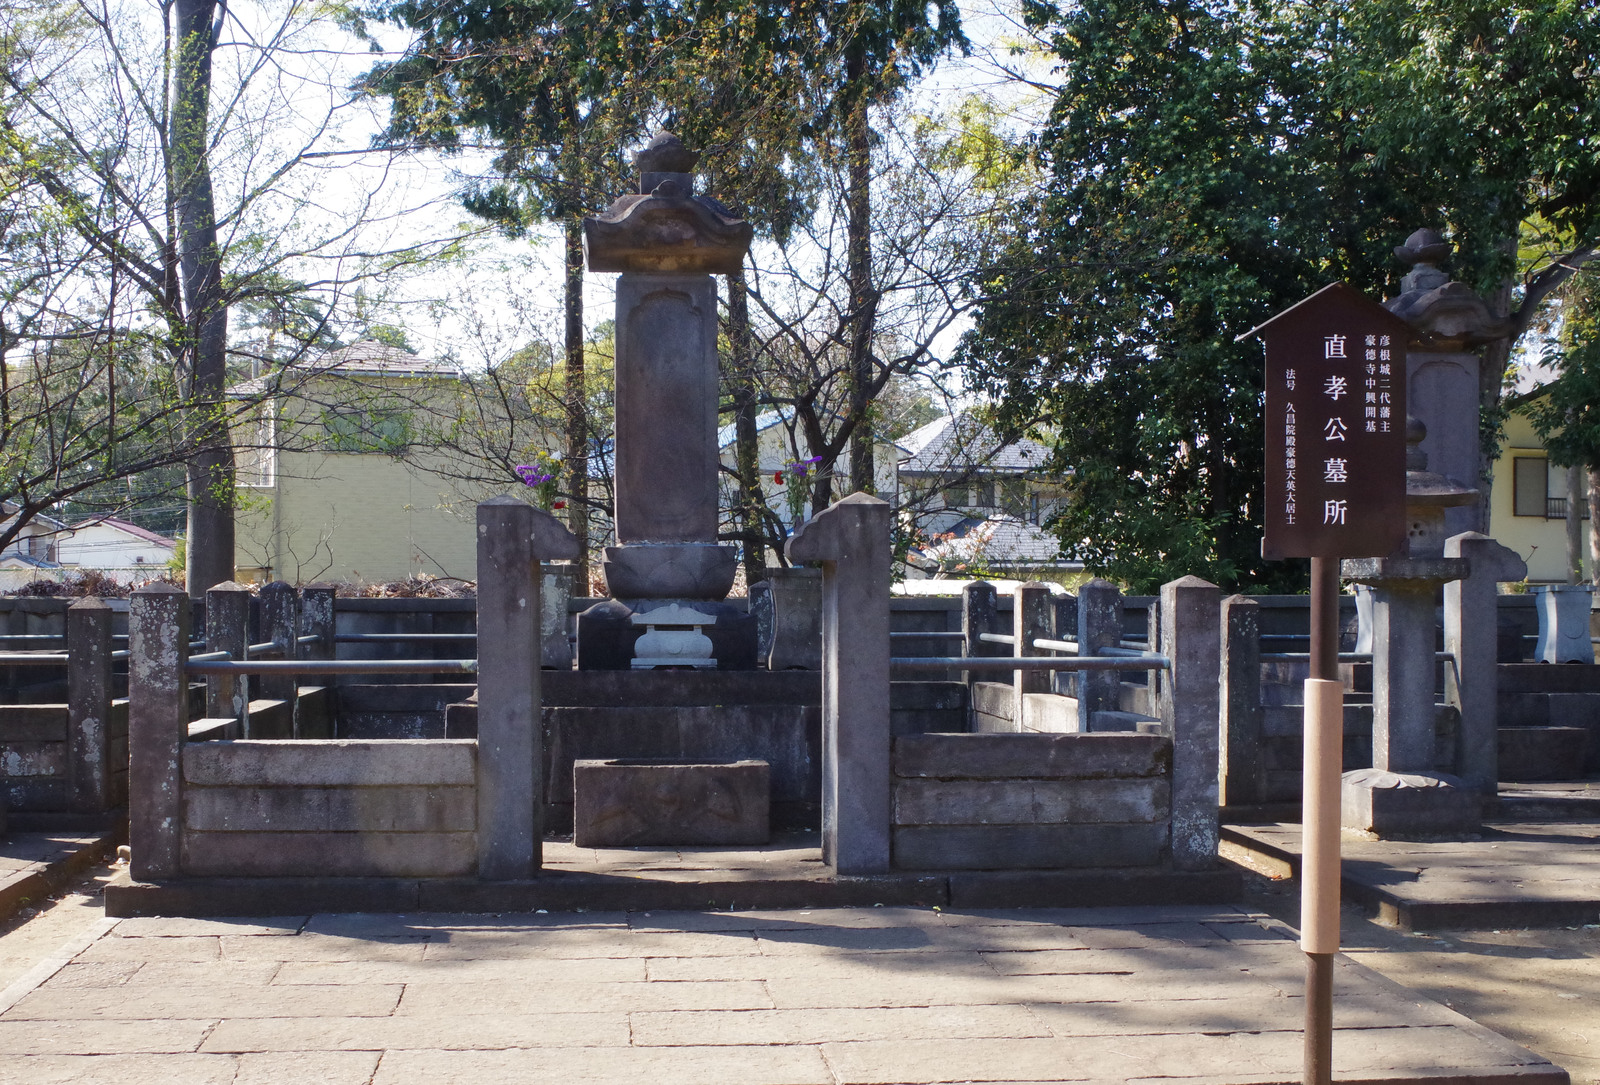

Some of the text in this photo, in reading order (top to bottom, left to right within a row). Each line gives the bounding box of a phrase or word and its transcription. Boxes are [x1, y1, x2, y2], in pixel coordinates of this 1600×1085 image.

[1285, 368, 1296, 391] 法号
[1379, 335, 1391, 432] 彦根城二代藩主
[1323, 334, 1348, 525] 直孝公墓所
